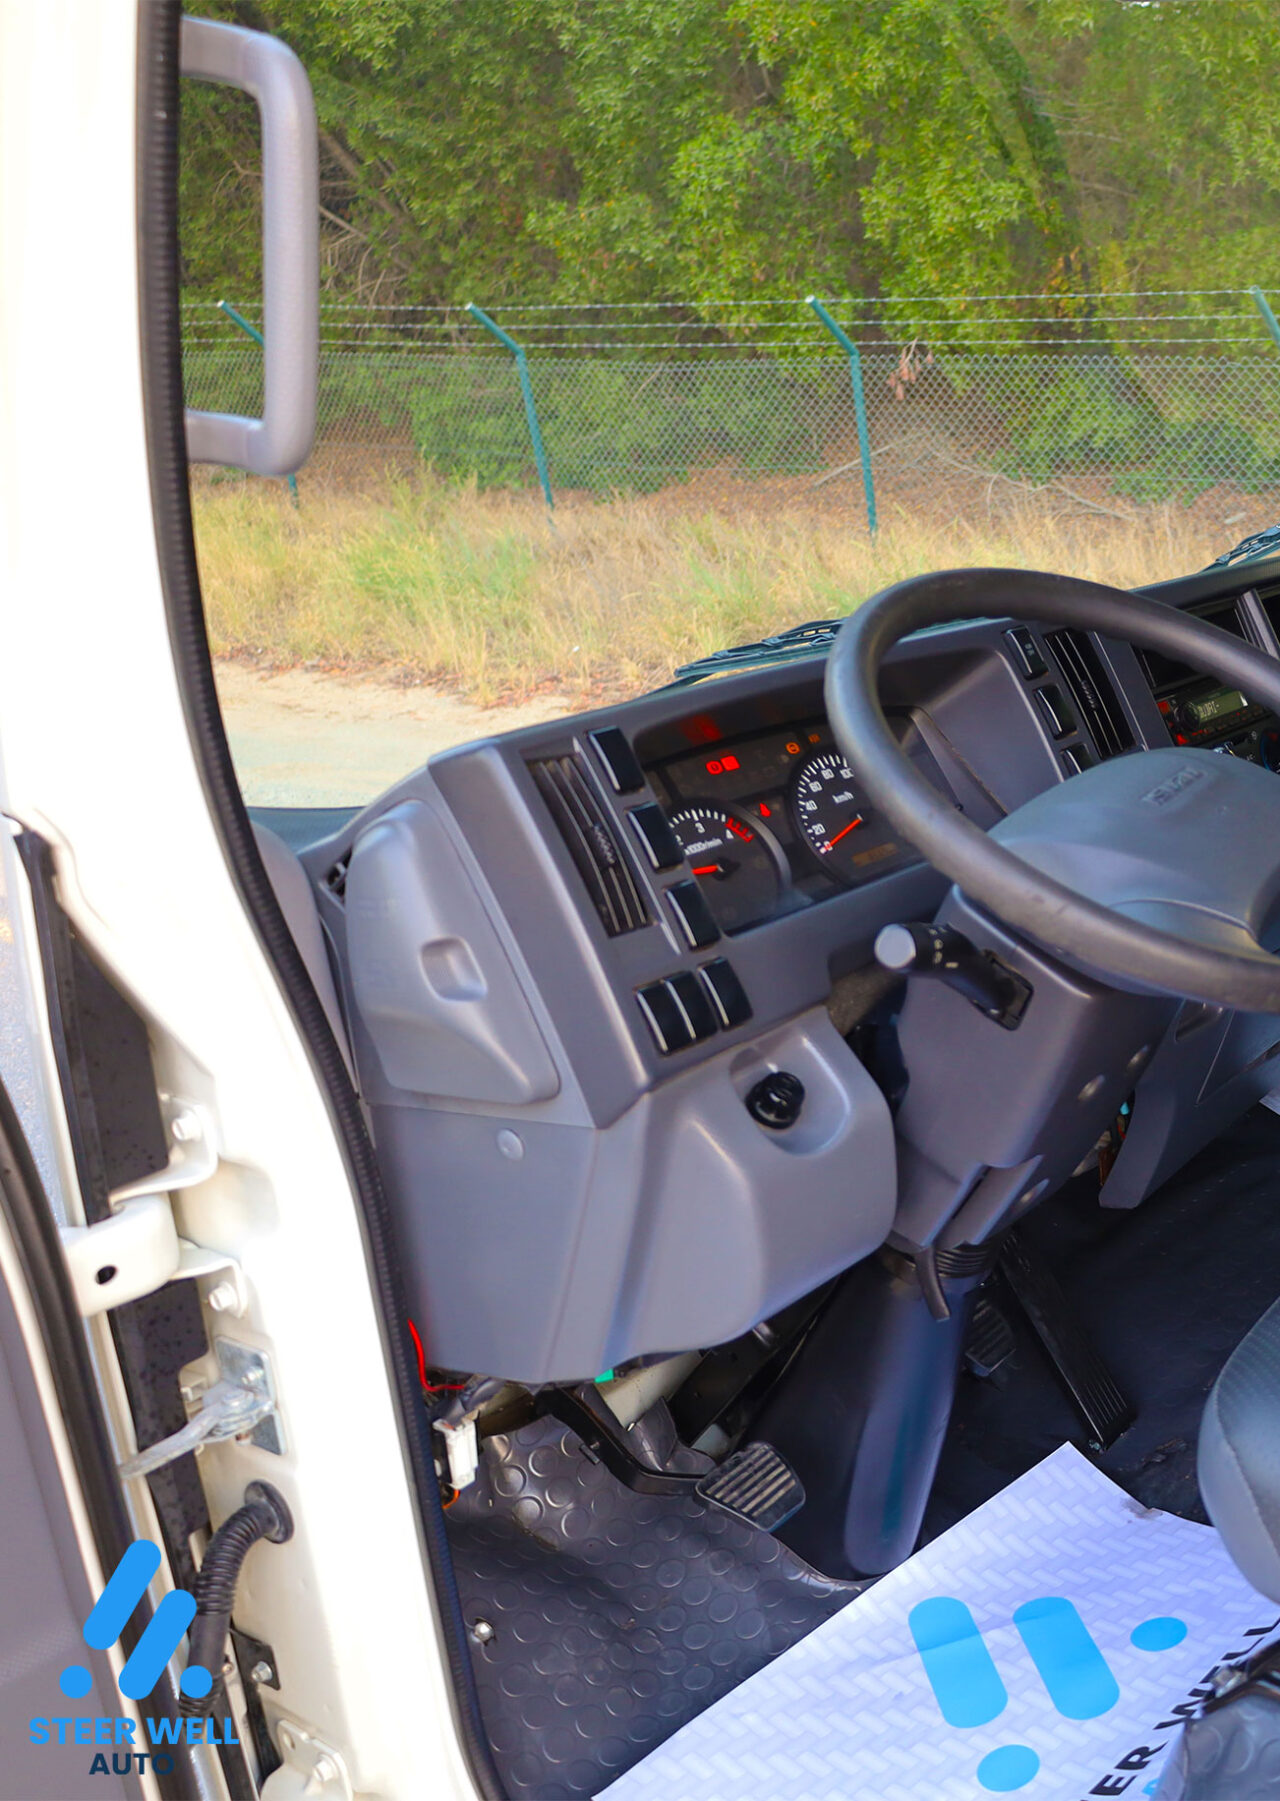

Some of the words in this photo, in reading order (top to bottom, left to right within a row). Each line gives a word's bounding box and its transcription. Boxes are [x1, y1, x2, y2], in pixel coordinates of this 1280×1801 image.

[821, 768, 835, 780] 80
[808, 780, 823, 793] 60
[832, 791, 854, 804] km/h
[805, 799, 818, 811] 40
[695, 822, 706, 834] 3
[725, 829, 735, 839] 4
[811, 823, 826, 835] 20
